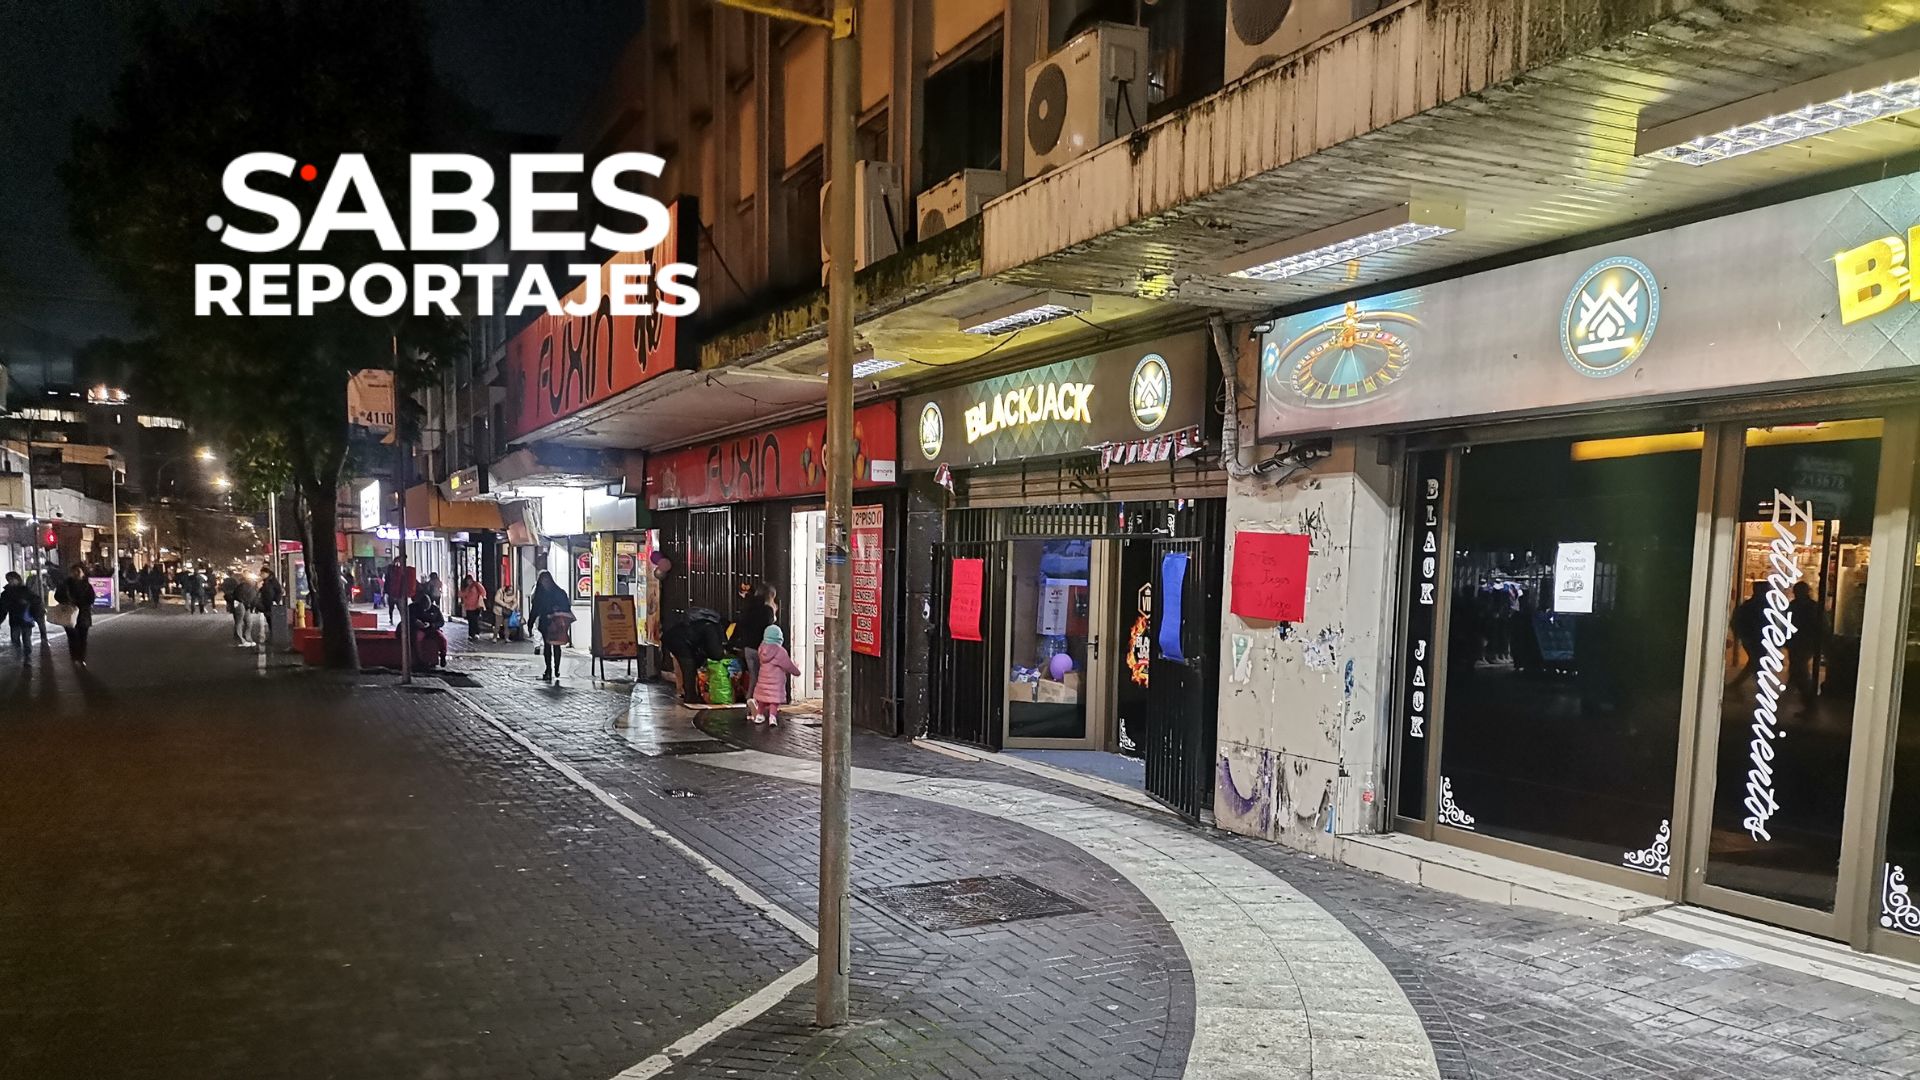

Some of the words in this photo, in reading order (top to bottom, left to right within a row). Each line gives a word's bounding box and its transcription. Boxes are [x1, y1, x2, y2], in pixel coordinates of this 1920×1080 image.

[964, 382, 1095, 444] BLACKJACK
[1420, 479, 1439, 605] BLACK
[1410, 640, 1426, 738] JACK
